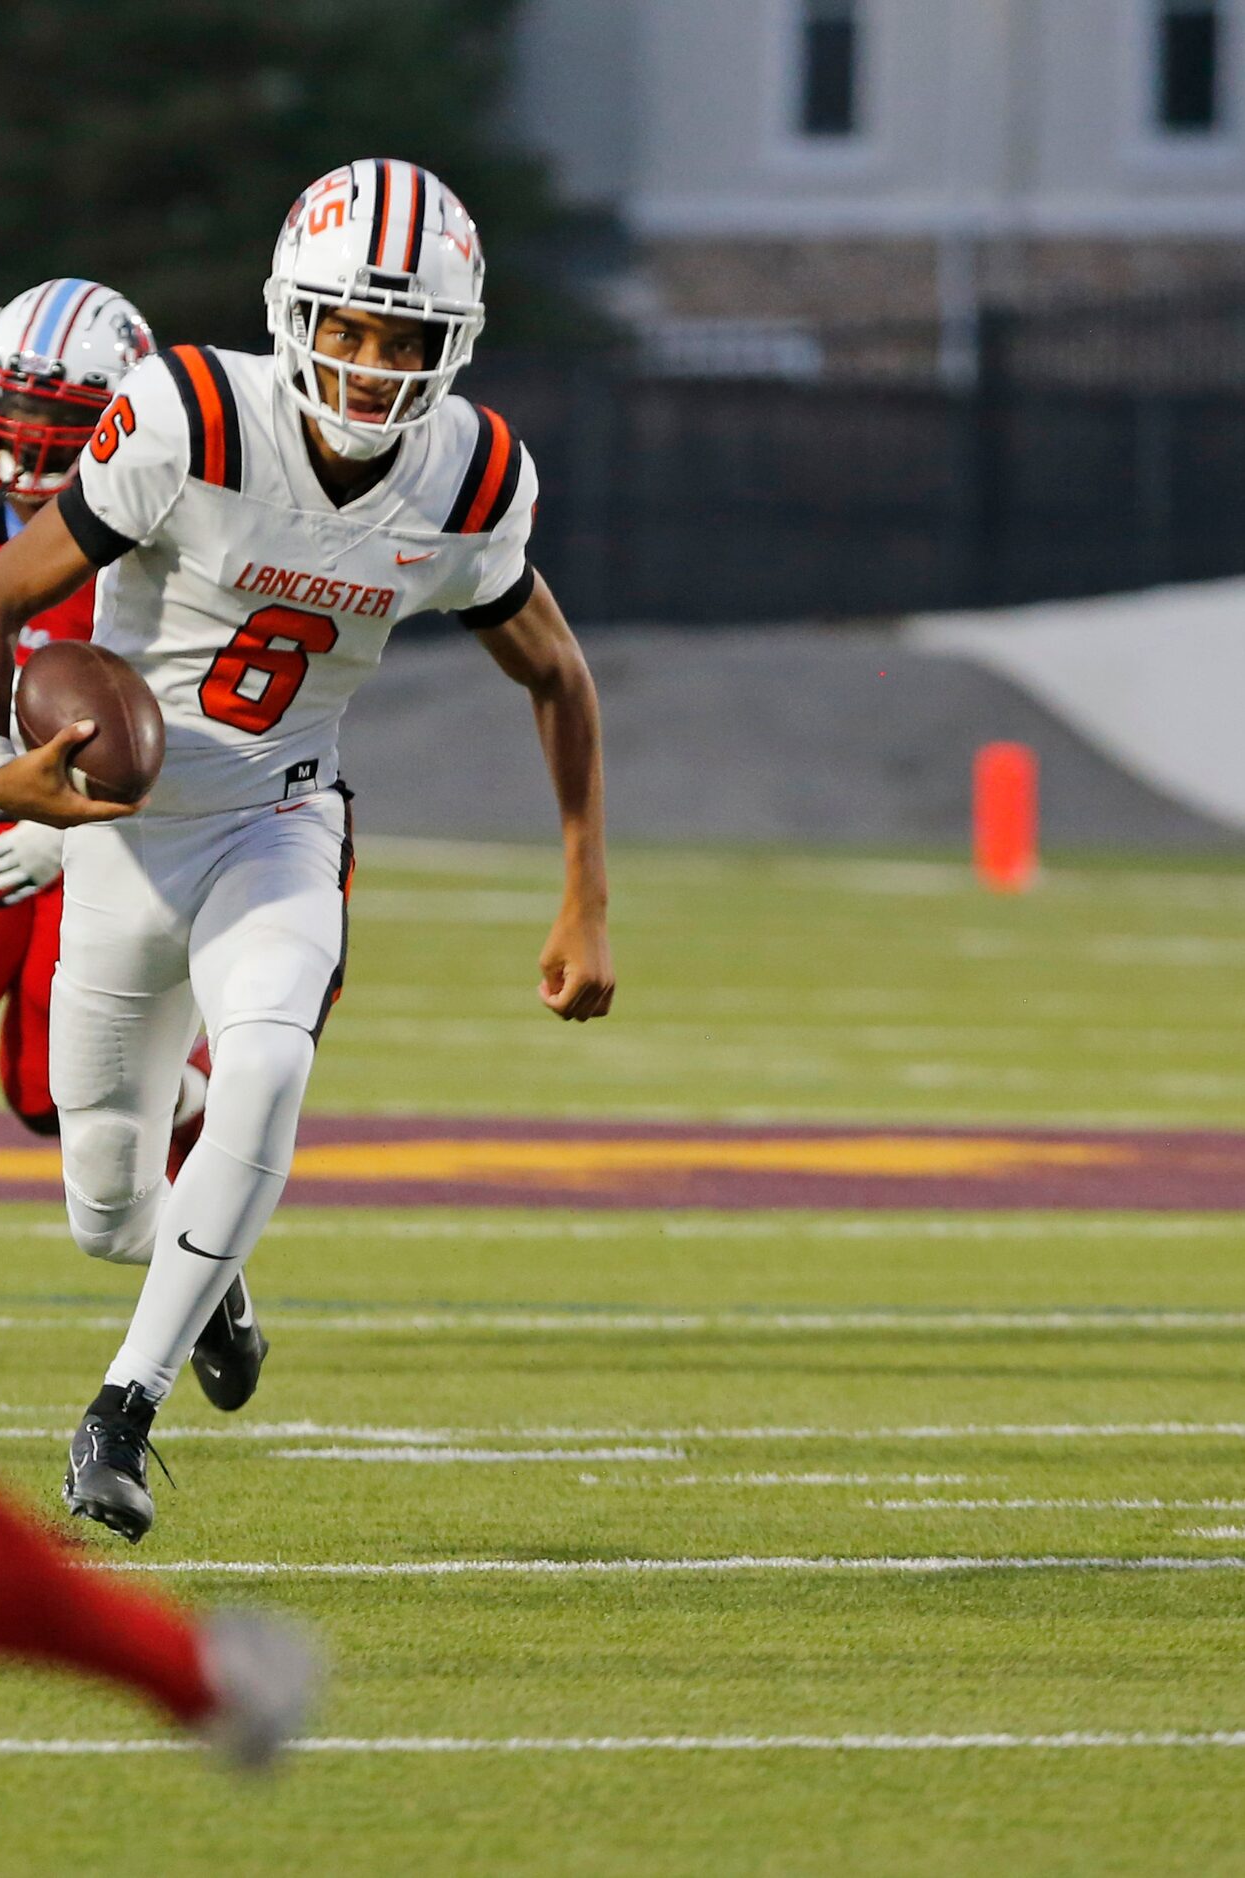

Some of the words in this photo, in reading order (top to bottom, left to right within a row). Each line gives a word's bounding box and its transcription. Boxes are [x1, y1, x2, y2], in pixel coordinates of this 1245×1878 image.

[90, 394, 136, 464] 6
[233, 561, 395, 617] LANCASTER
[198, 603, 339, 736] 6
[298, 764, 311, 778] M
